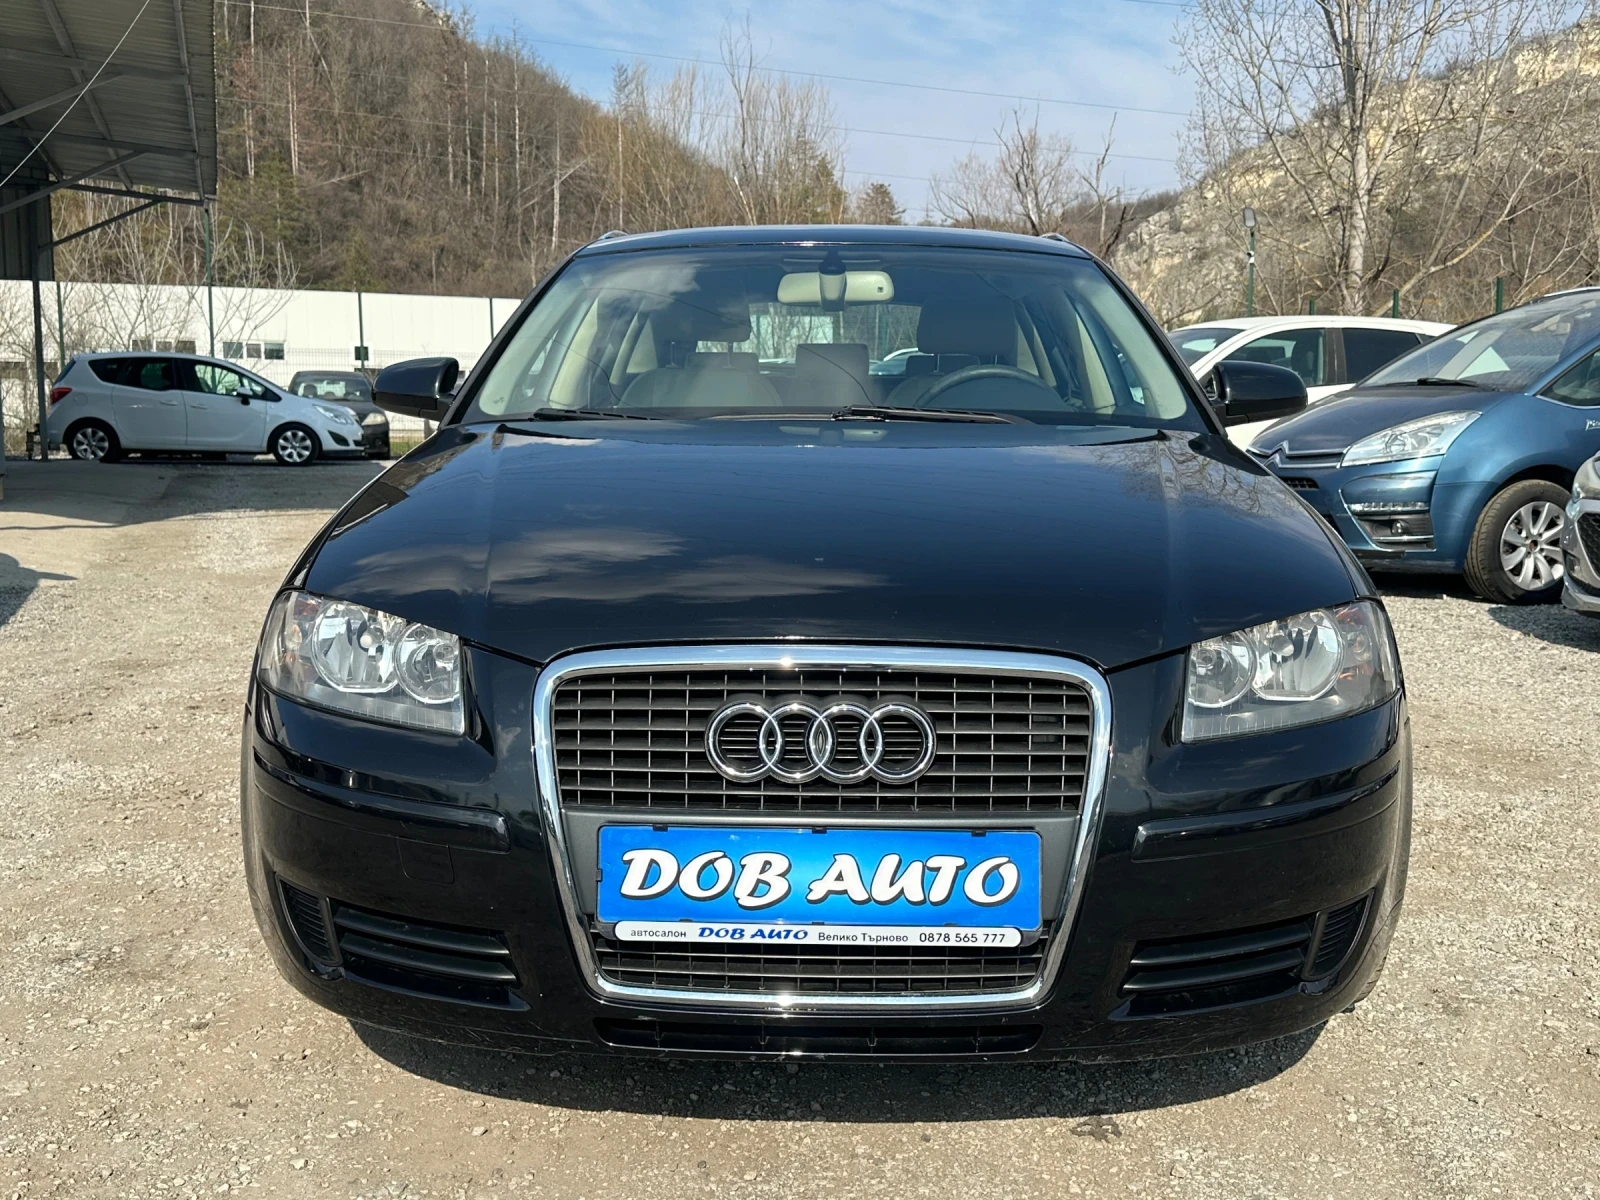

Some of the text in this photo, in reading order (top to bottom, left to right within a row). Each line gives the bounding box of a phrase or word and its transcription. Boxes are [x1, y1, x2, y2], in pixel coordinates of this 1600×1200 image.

[620, 848, 1020, 910] DOB AUTO
[630, 927, 1006, 943] автосалон DOB AUTO Велико Търново 0878 565 777
